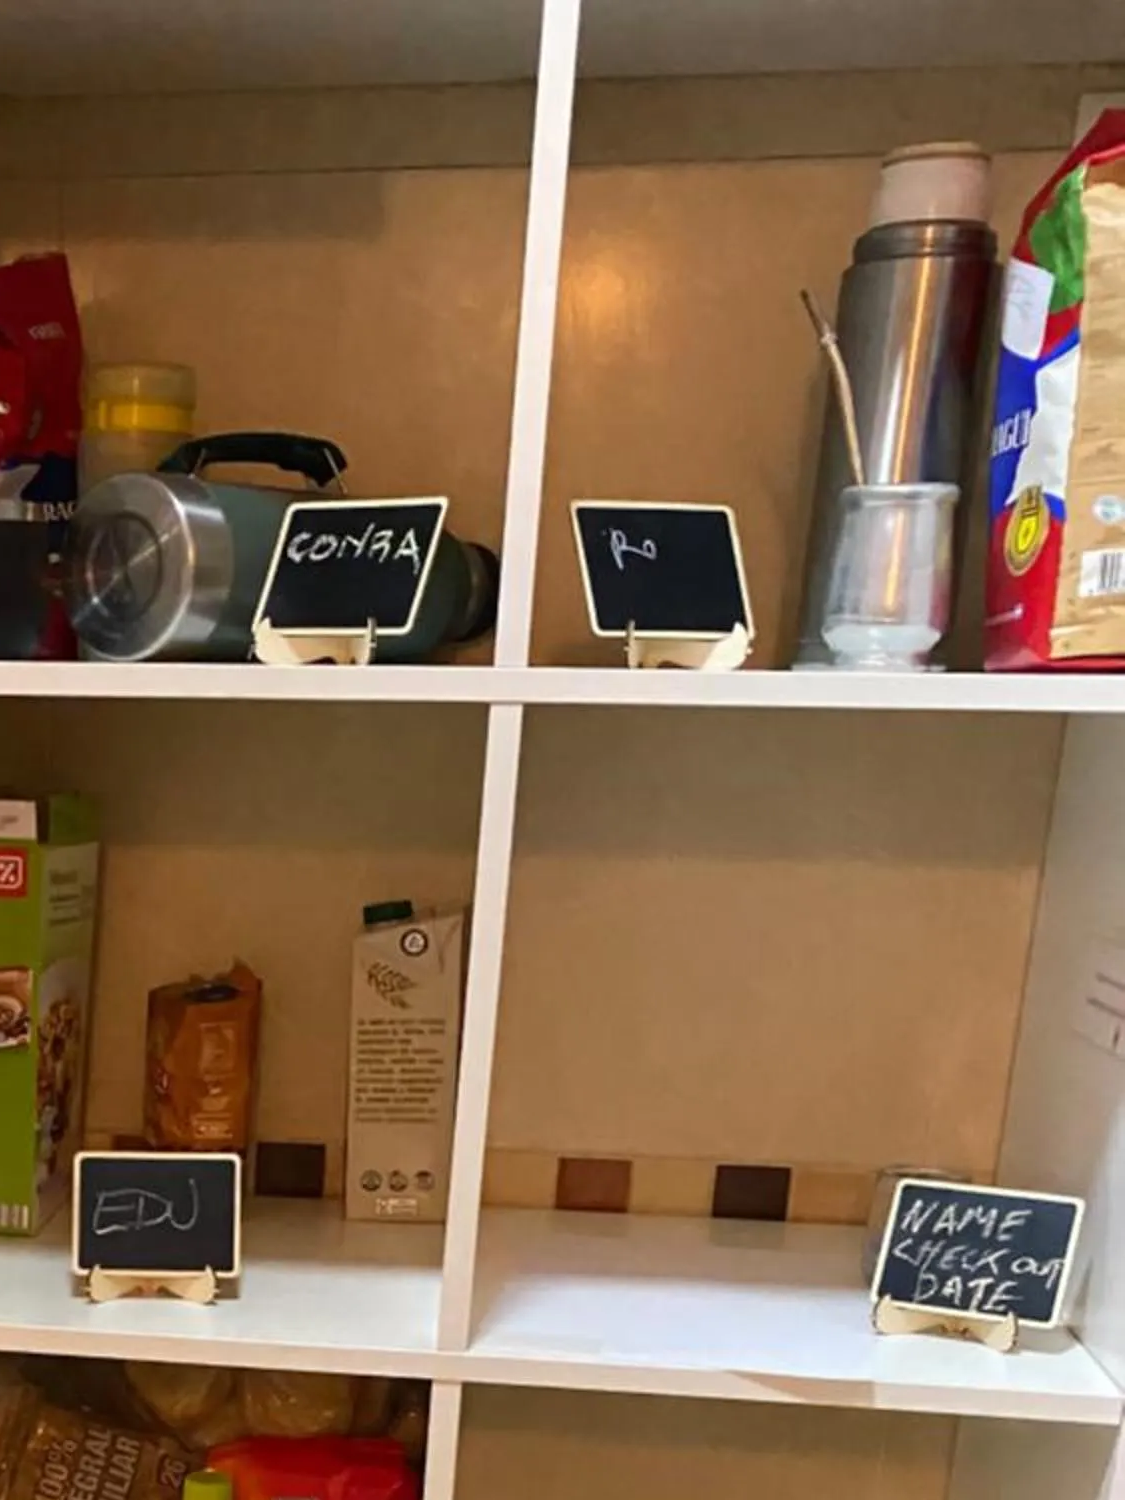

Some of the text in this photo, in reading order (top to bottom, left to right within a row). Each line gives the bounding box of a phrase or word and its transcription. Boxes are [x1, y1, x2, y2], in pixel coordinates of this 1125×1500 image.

[92, 1178, 199, 1235] EDU
[900, 1198, 1033, 1242] NAME
[891, 1238, 1011, 1276] CHECK
[914, 1268, 1024, 1312] DATE
